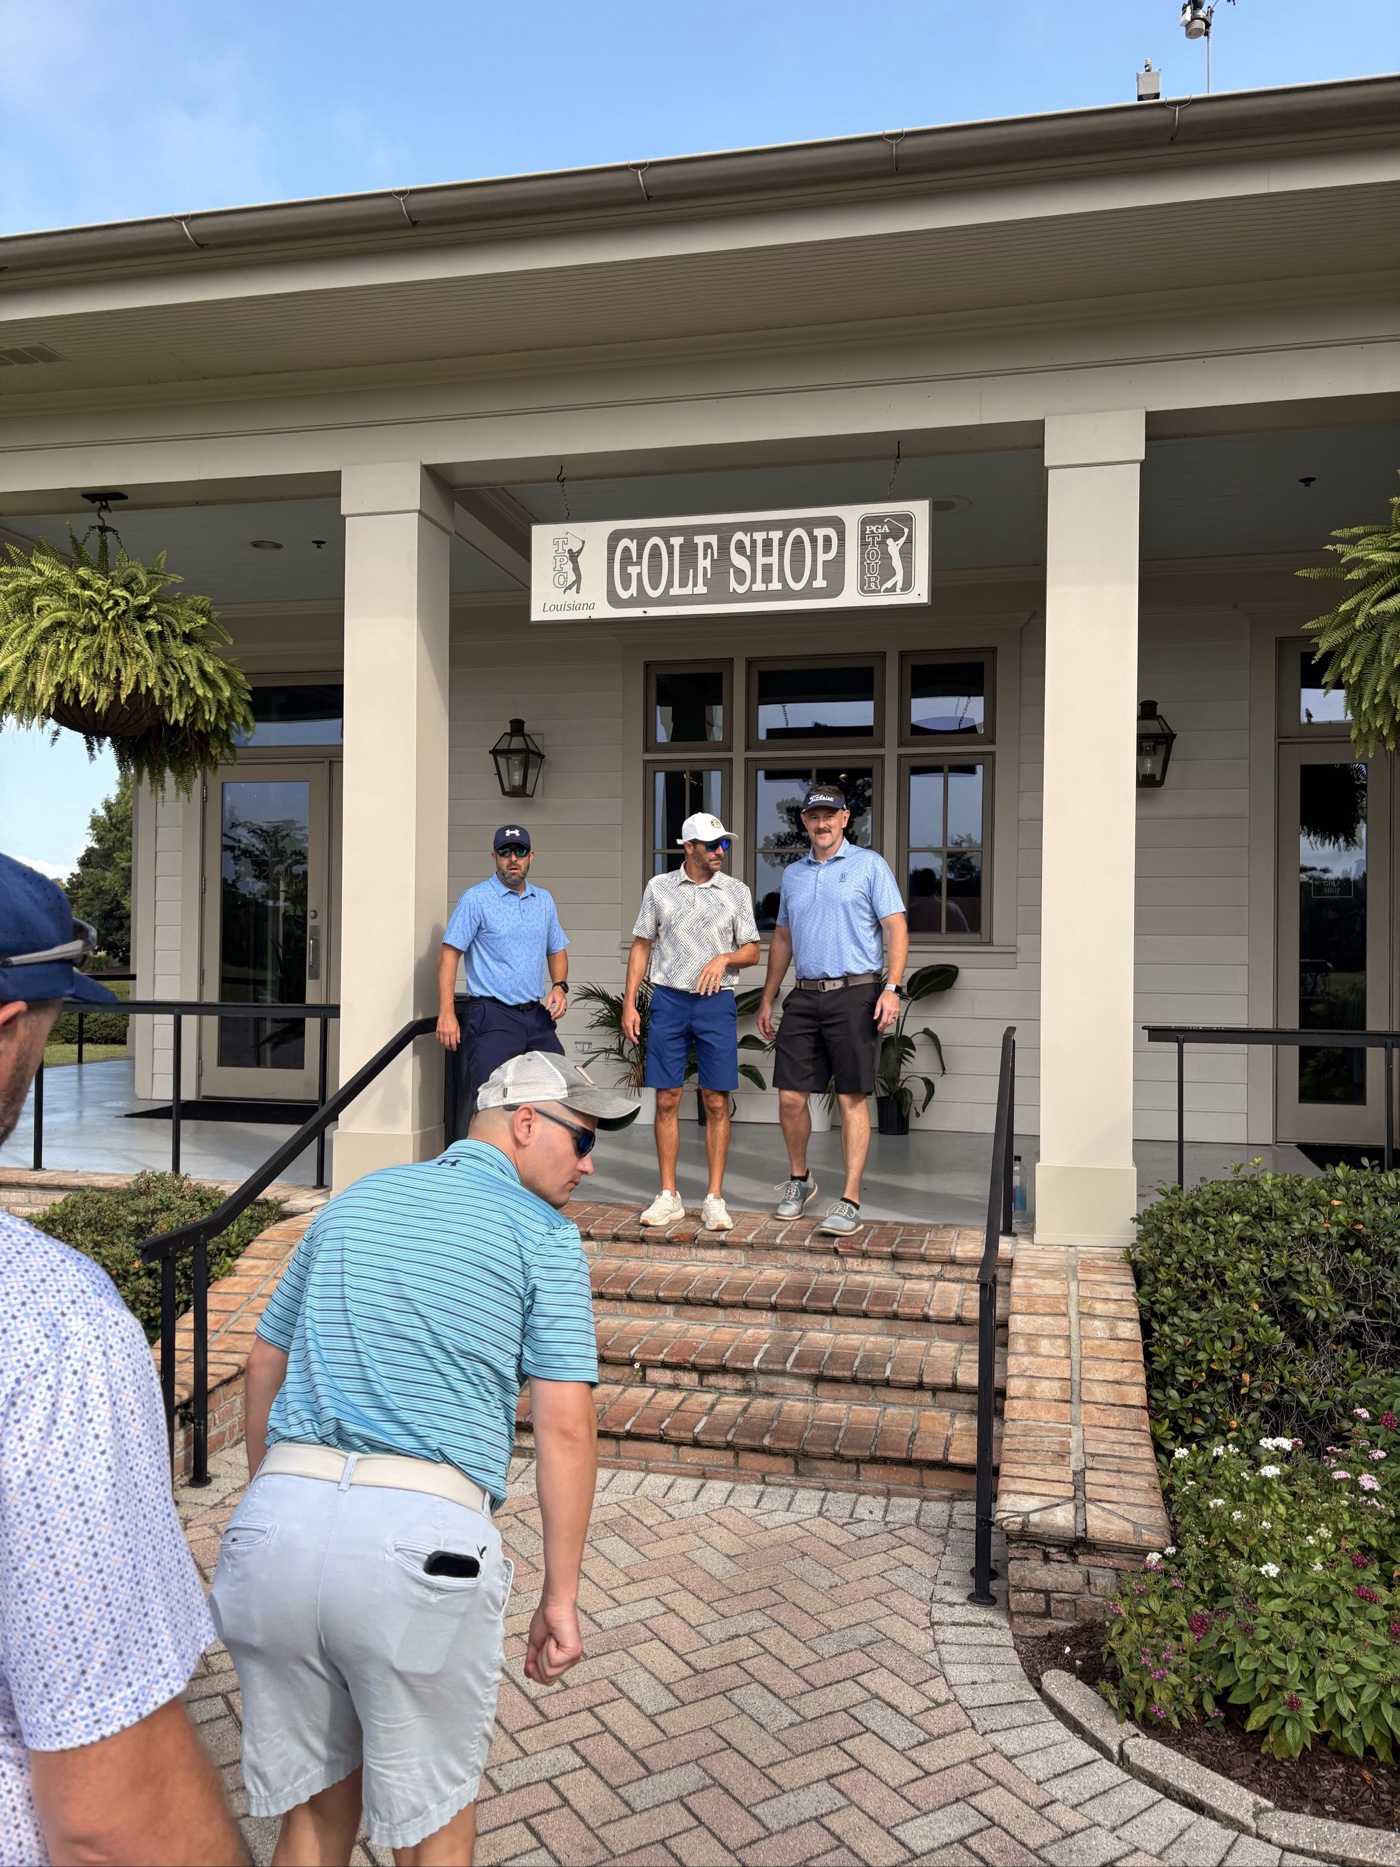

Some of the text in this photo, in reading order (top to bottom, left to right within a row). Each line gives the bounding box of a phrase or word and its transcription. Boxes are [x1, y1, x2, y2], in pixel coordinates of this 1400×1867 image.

[865, 525, 890, 534] PGA
[552, 537, 568, 589] TPC
[613, 527, 838, 599] GOLF SHOP
[864, 533, 881, 590] TOUR
[542, 600, 595, 612] Louisiana
[808, 794, 834, 804] Titleist
